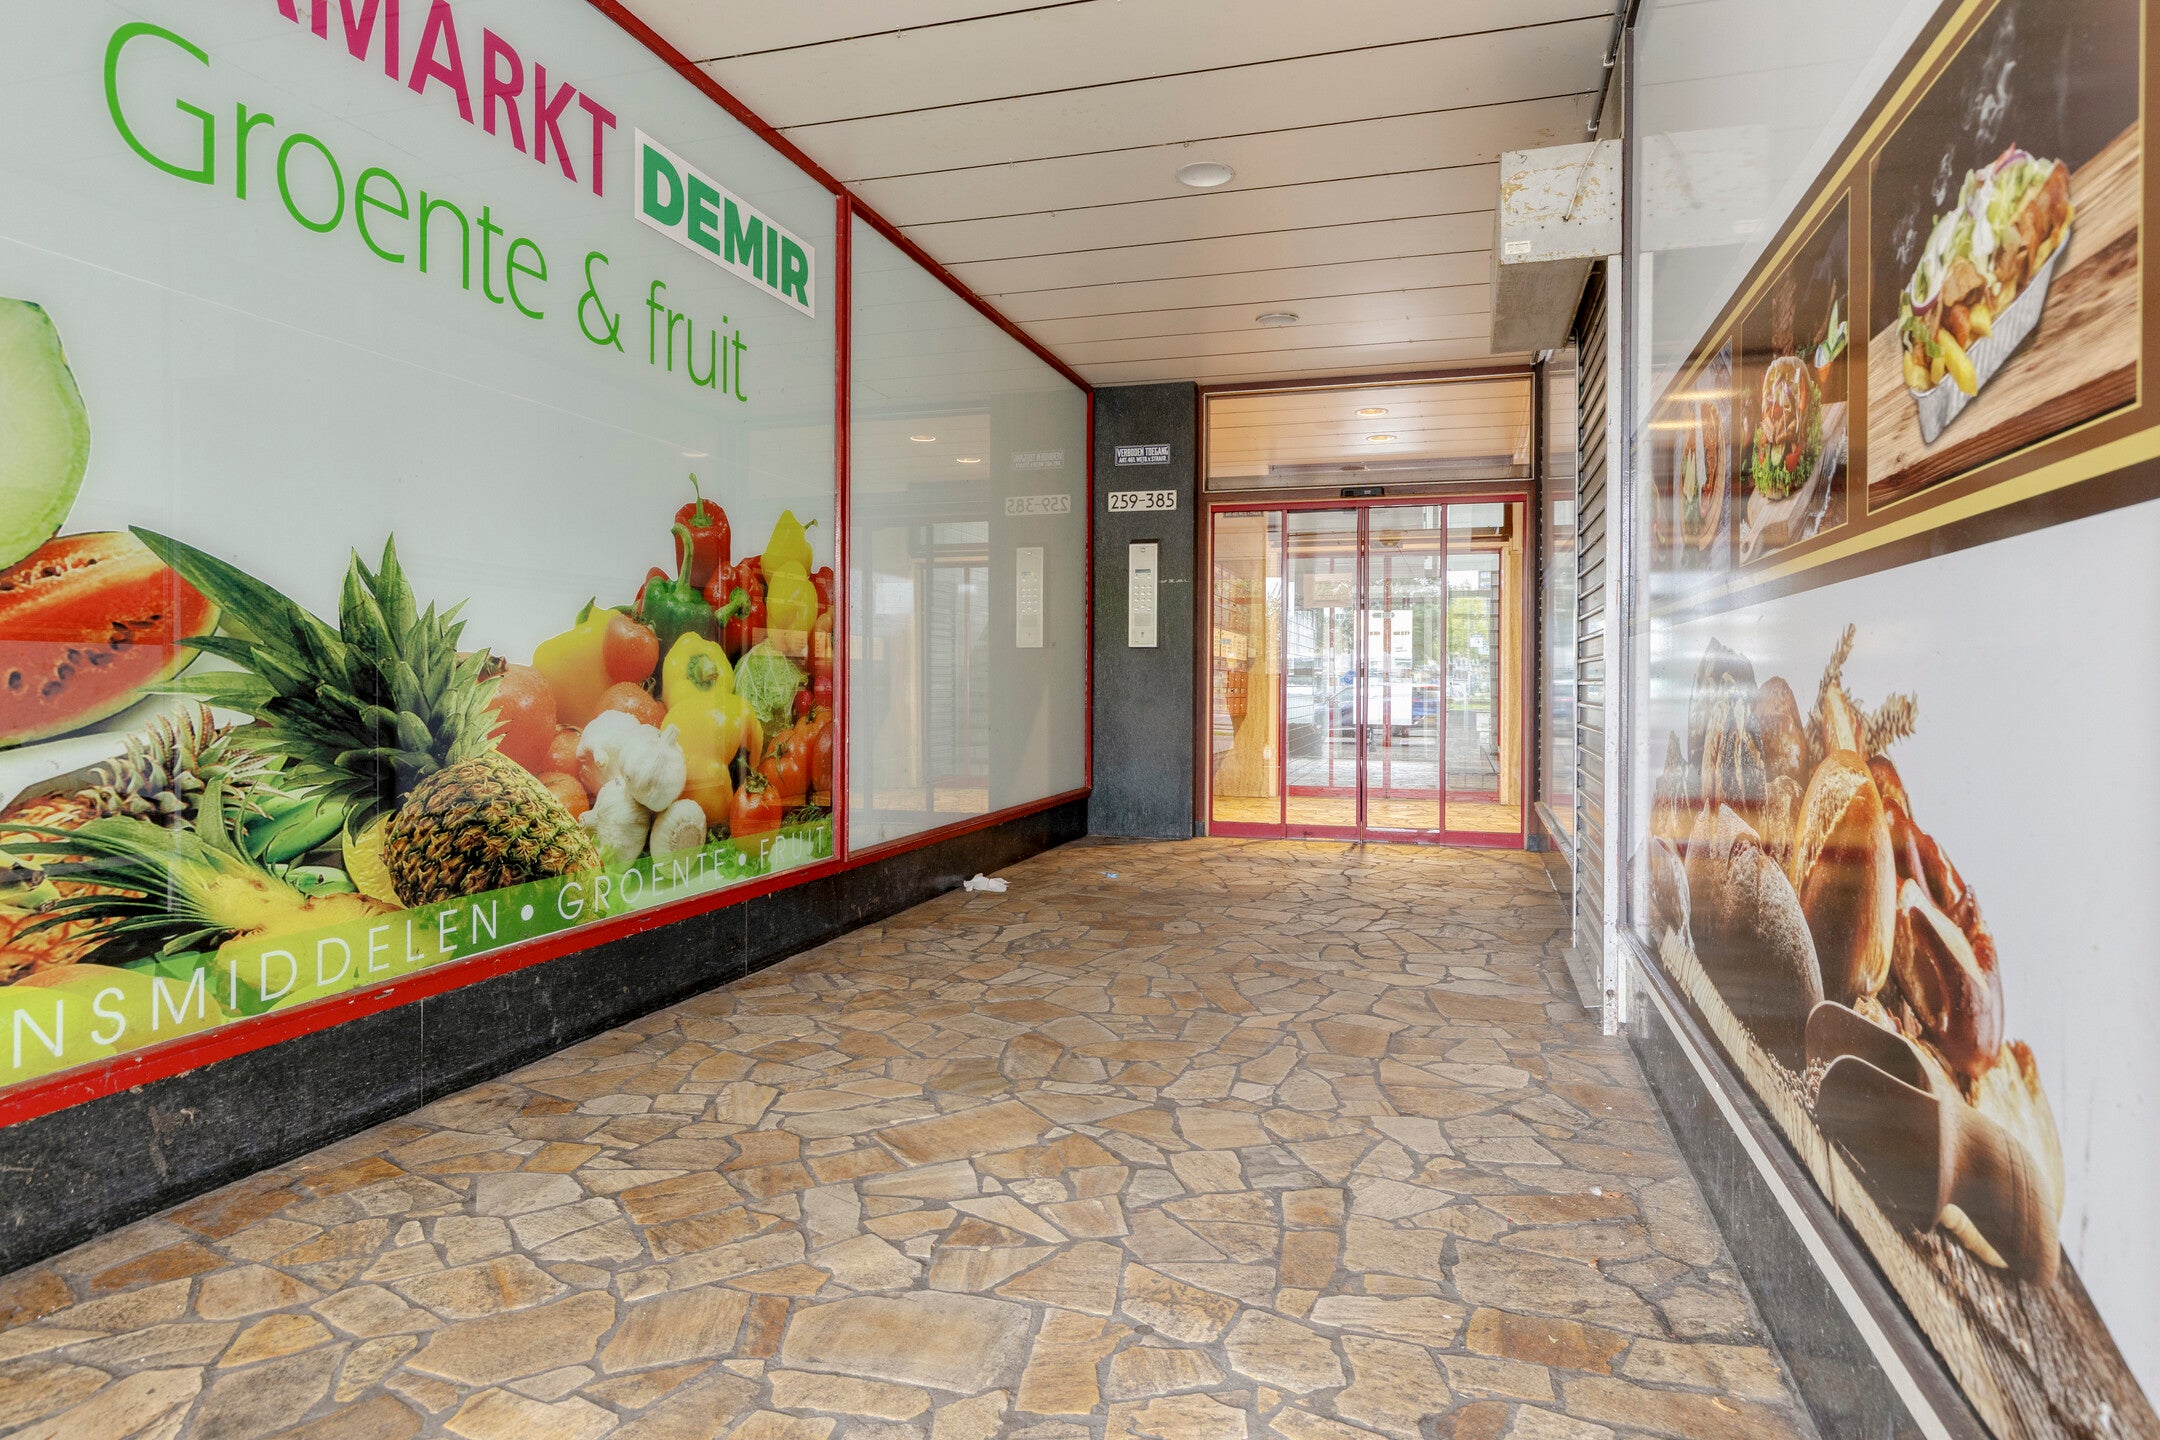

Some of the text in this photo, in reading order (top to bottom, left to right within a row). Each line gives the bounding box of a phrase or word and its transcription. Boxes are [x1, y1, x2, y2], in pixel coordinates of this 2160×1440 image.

[275, 0, 617, 198] MARKT
[104, 21, 748, 403] Groente & fruit
[641, 141, 811, 309] DEMIR
[1110, 492, 1175, 509] 259-385
[557, 826, 824, 920] GROENTE FRUIT
[12, 898, 498, 1070] NSMIDDELEN
